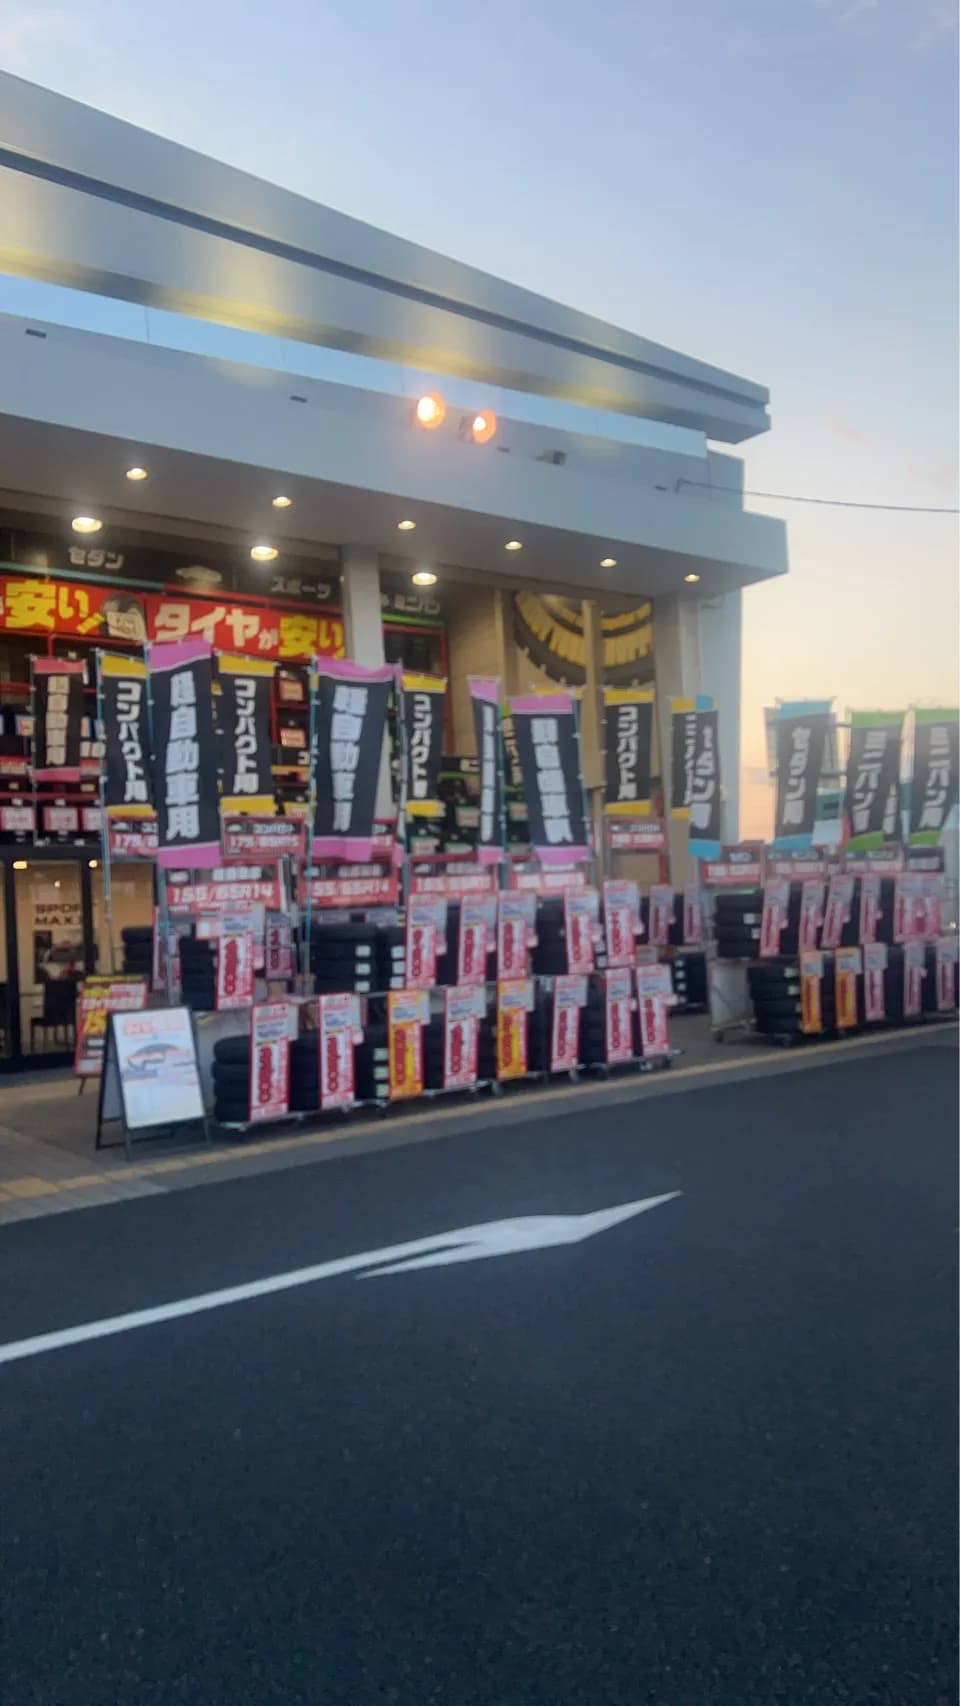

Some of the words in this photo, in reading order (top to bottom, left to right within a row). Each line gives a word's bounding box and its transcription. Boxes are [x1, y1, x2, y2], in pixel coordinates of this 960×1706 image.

[69, 547, 124, 569] セダン
[116, 681, 148, 802] コンパクト用
[233, 678, 260, 794] コンパクト用
